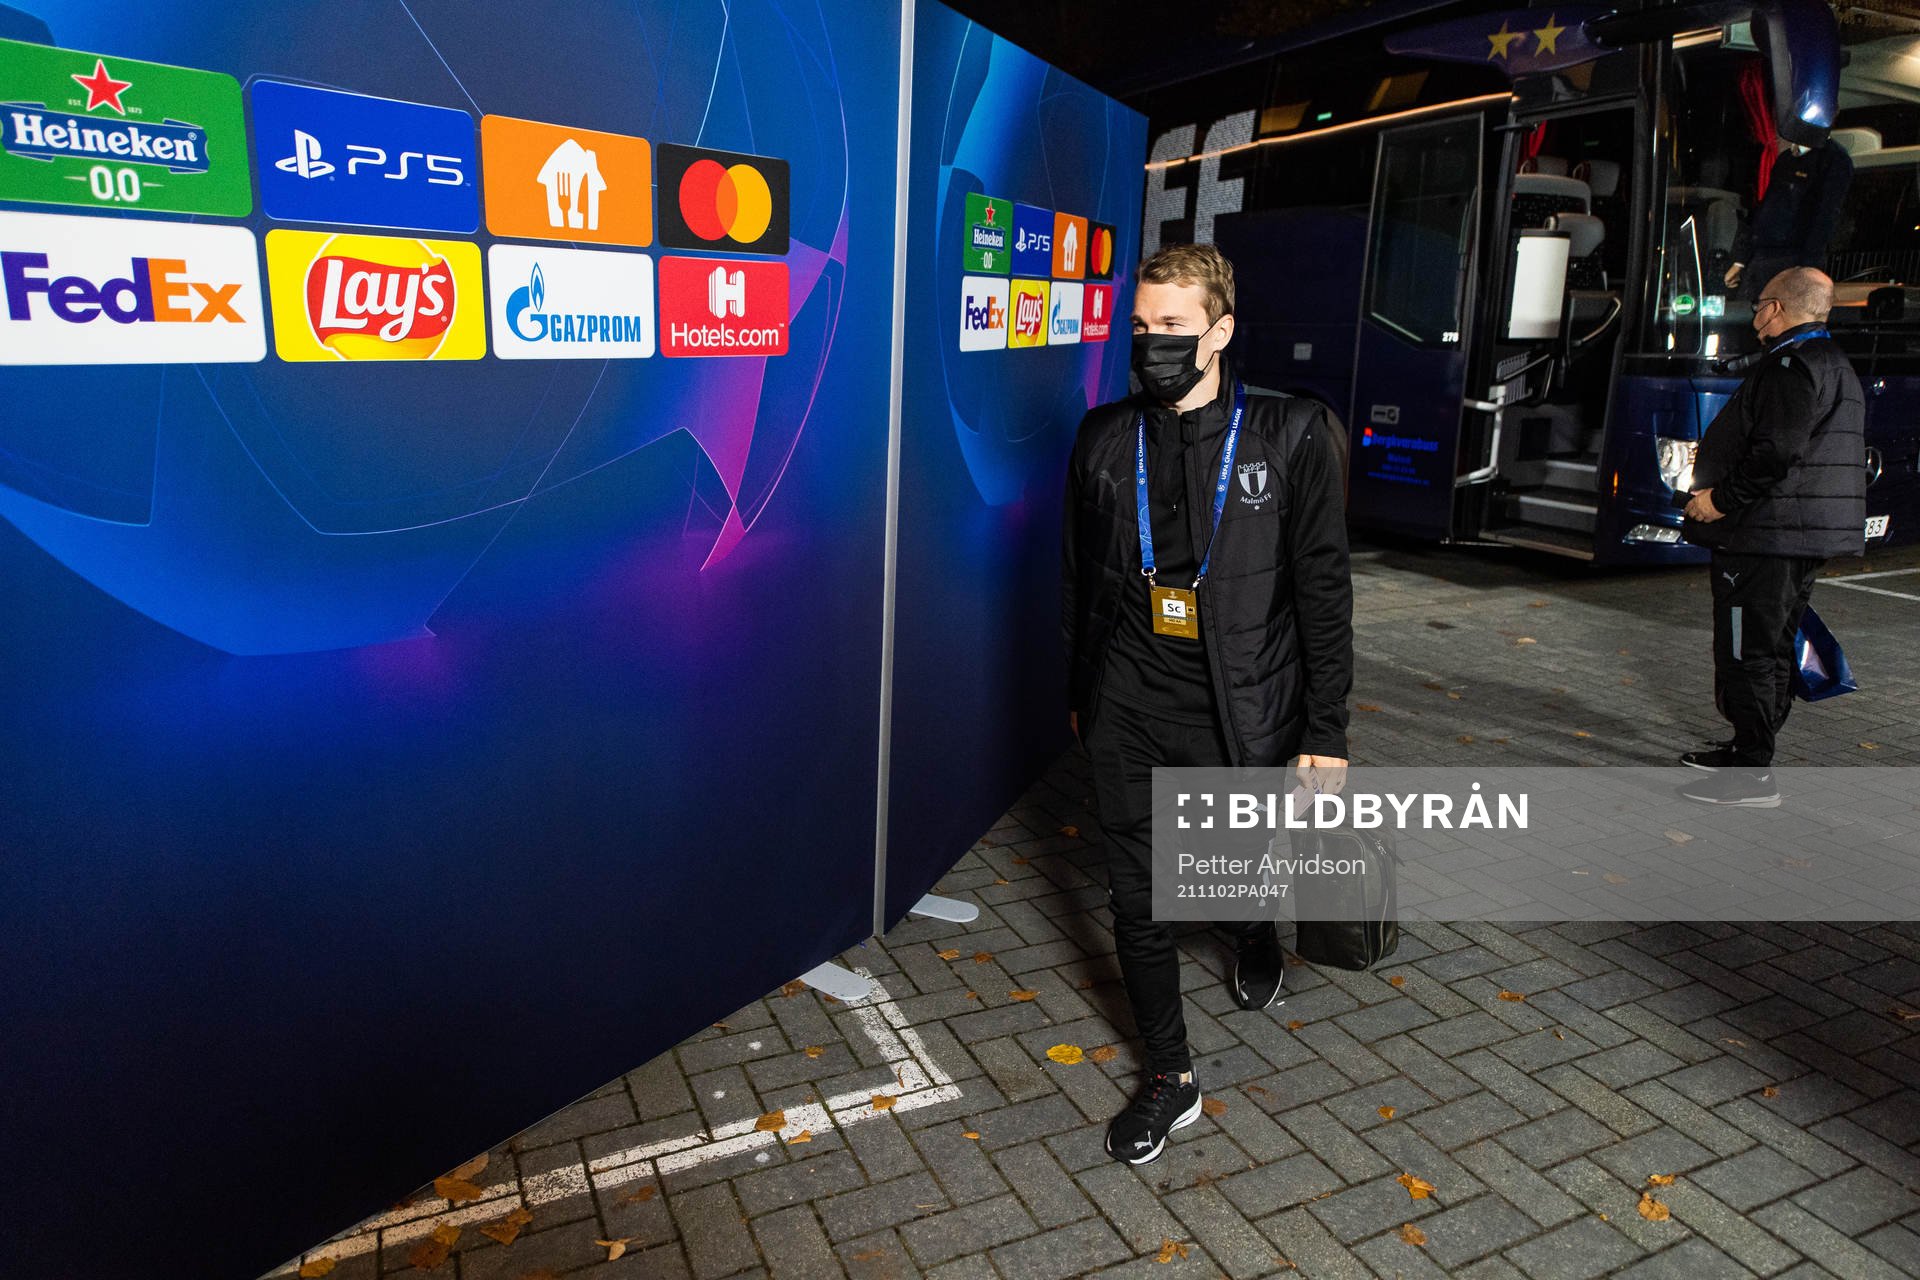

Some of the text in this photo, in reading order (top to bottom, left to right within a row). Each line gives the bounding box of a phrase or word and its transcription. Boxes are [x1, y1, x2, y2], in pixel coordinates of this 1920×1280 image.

[10, 112, 198, 163] Heineken
[346, 144, 465, 187] PS5
[89, 166, 141, 202] 0.0
[973, 228, 1004, 248] Heineken
[1028, 232, 1051, 252] PS5
[1, 250, 247, 325] FedEx
[319, 258, 448, 343] Lay's
[549, 314, 642, 343] GAZPROM
[965, 295, 1005, 331] FedEx
[1016, 293, 1043, 337] Lay's
[671, 323, 779, 348] Hotels.com
[1221, 408, 1243, 480] UEFA CHAMPIONS LEAGUE
[1239, 491, 1272, 504] Malmö FF
[1865, 519, 1883, 536] 83
[1167, 603, 1181, 613] Sc
